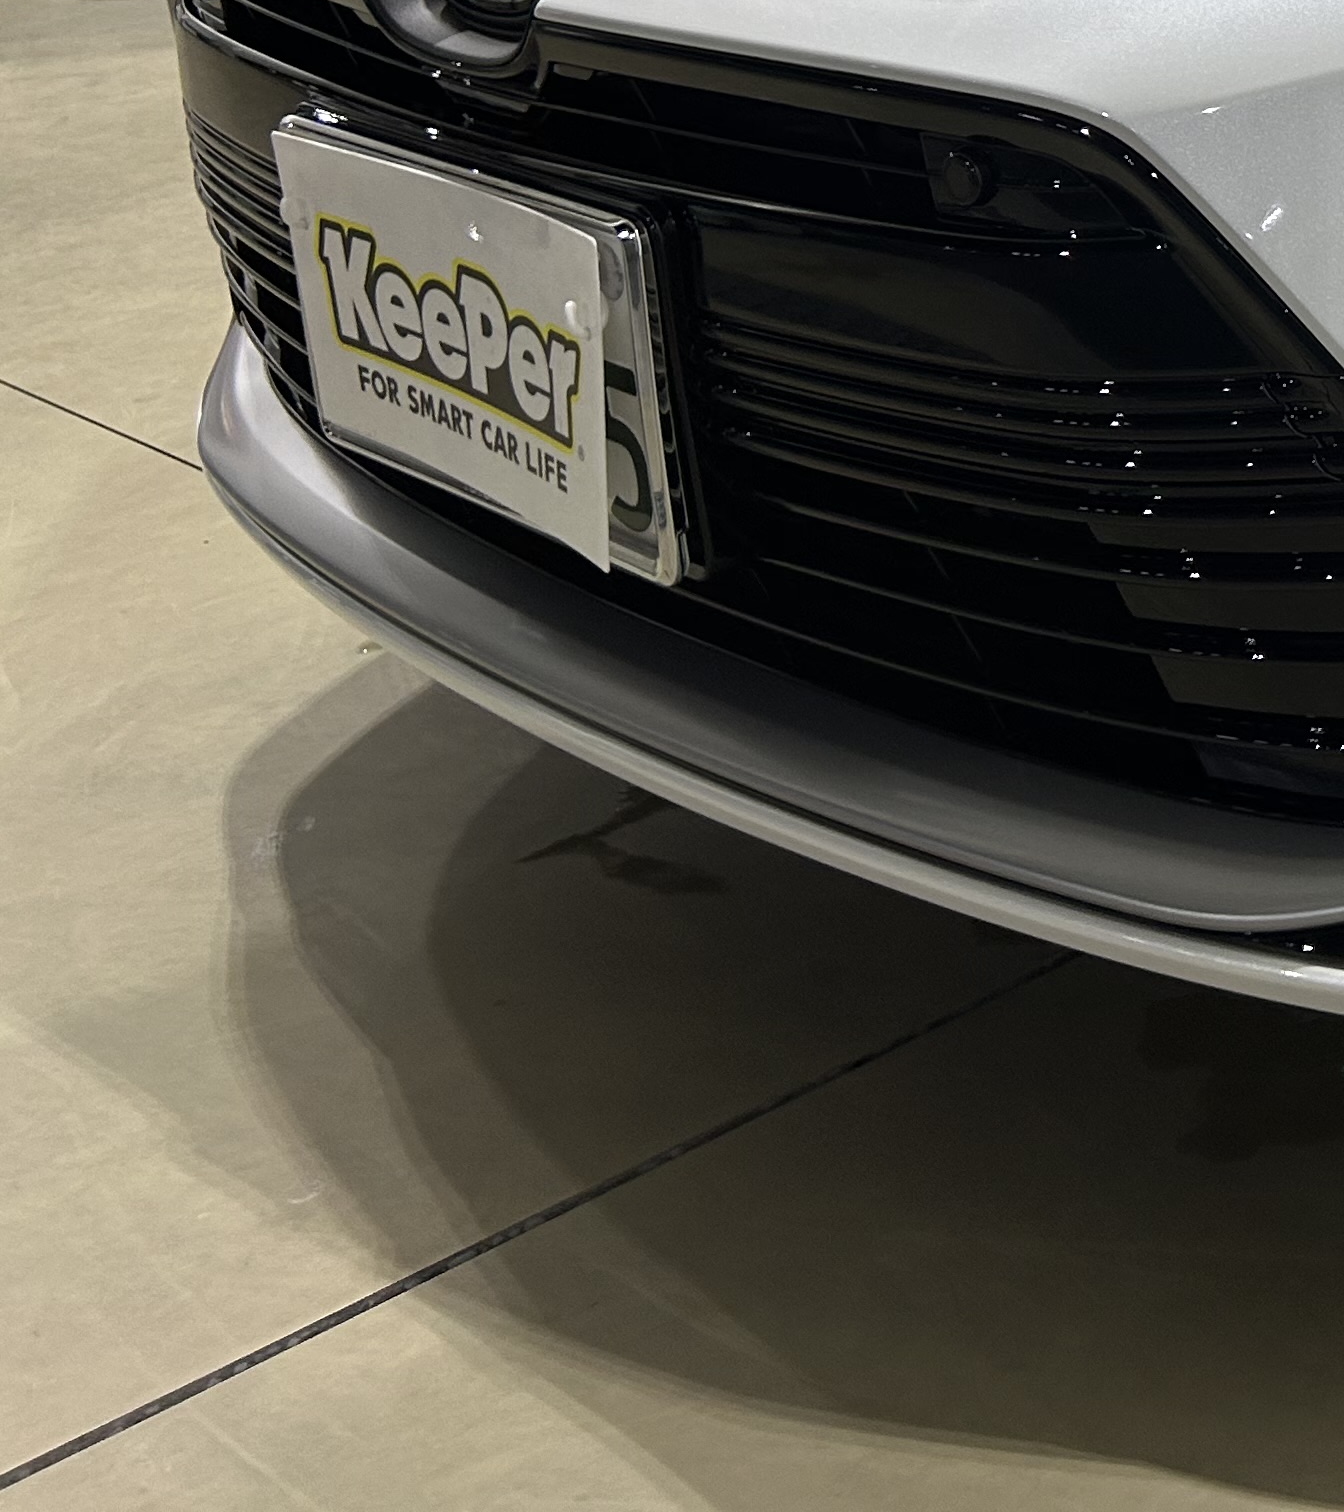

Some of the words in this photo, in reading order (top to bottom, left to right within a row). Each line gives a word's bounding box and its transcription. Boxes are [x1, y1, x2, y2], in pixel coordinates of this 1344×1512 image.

[317, 215, 581, 449] KeePer
[357, 363, 402, 407] FOR
[408, 385, 474, 442] SMART
[480, 419, 519, 466] CAR
[525, 445, 569, 495] LIFE
